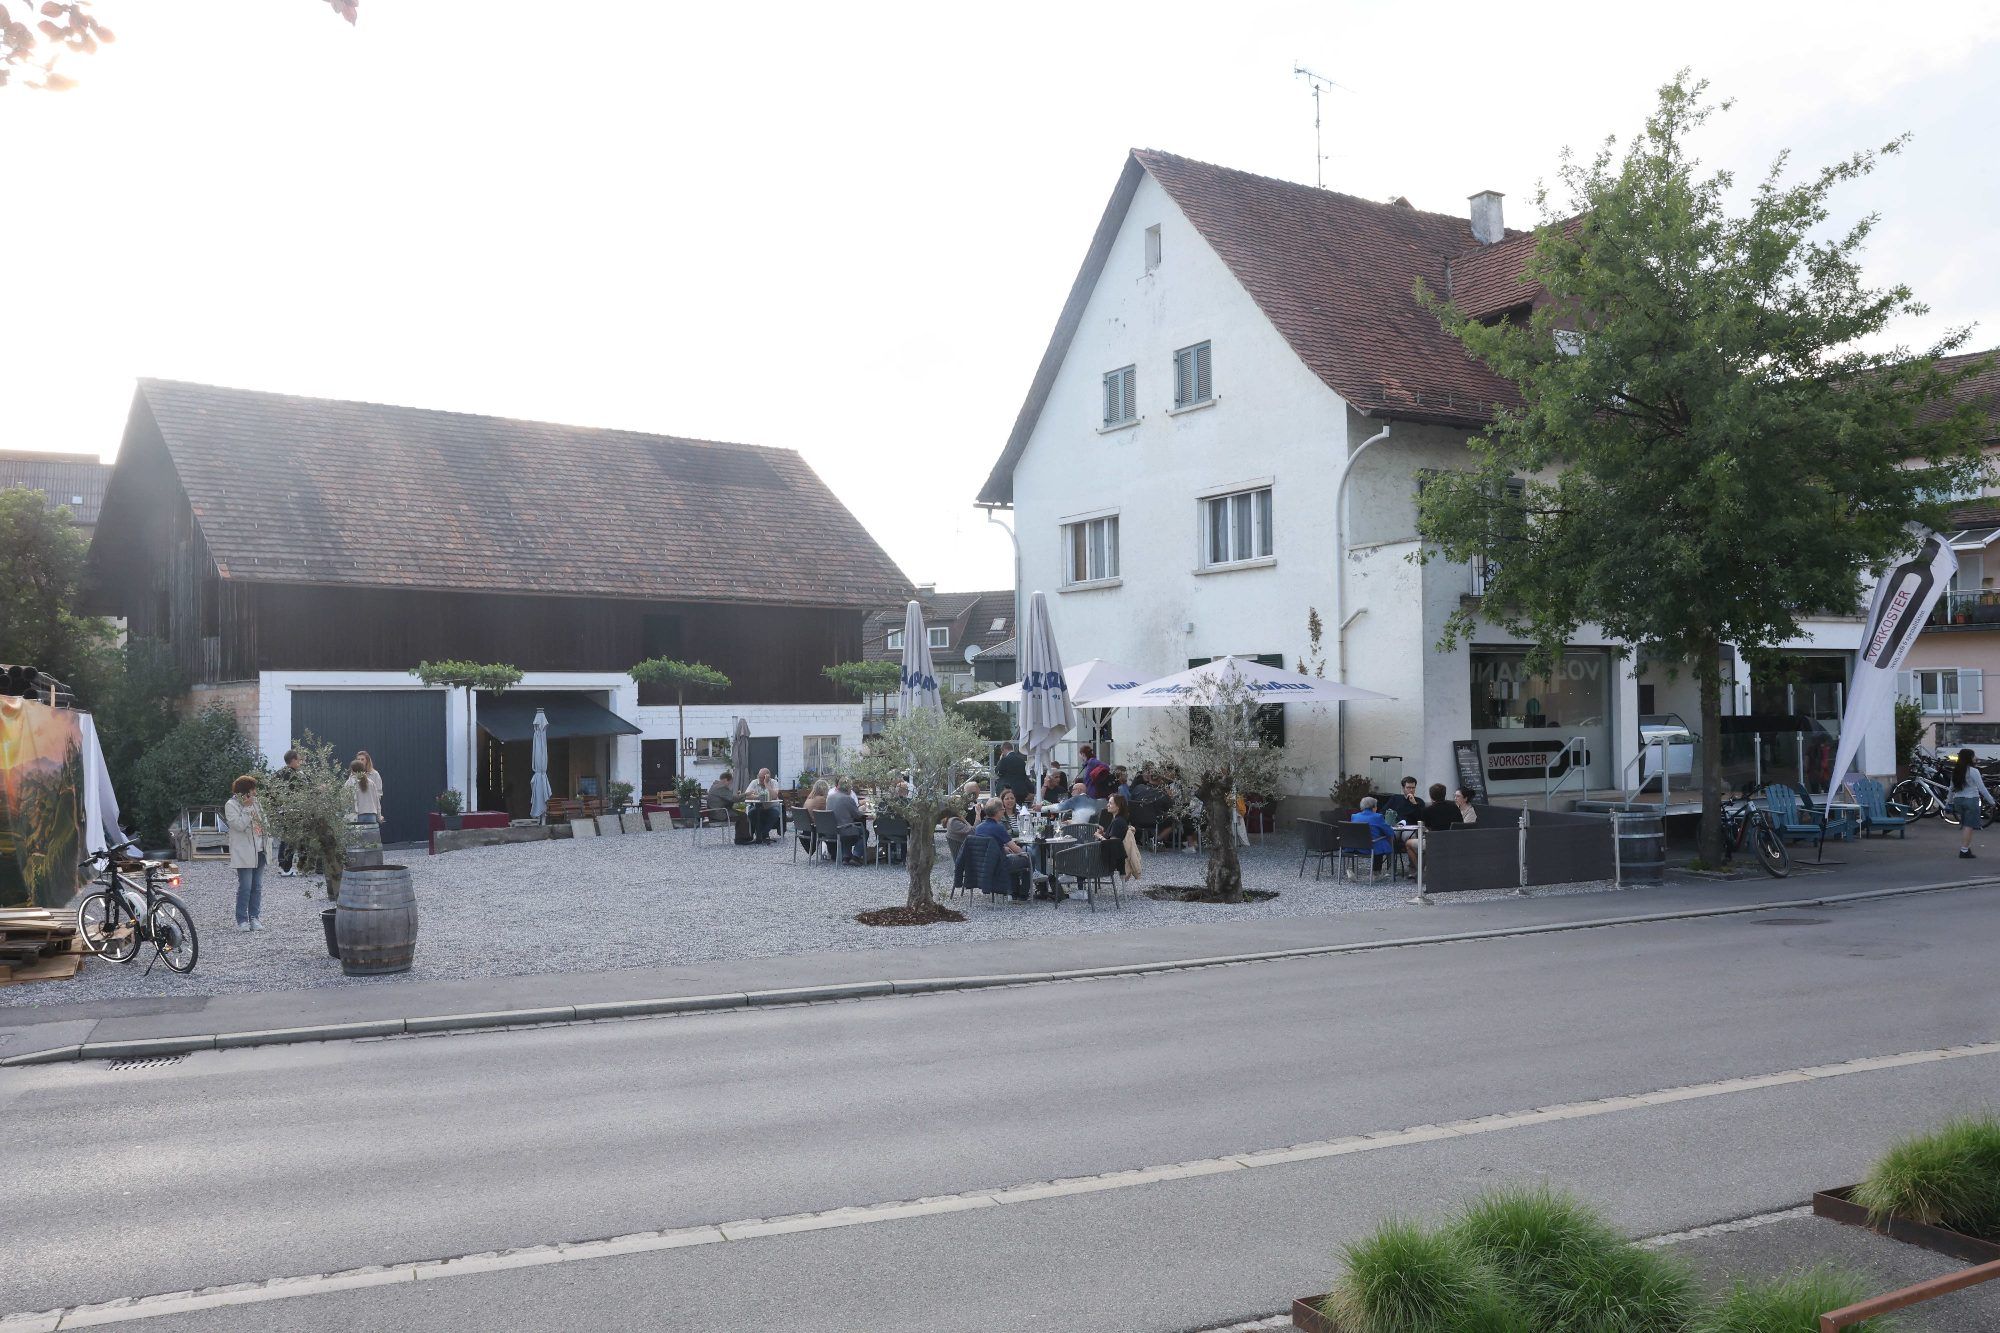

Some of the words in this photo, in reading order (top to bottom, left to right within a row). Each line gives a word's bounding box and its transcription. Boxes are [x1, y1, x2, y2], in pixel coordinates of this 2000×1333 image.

[1869, 590, 1911, 658] VORKOSTER
[684, 737, 694, 749] 16
[1493, 754, 1547, 767] VORKOSTER
